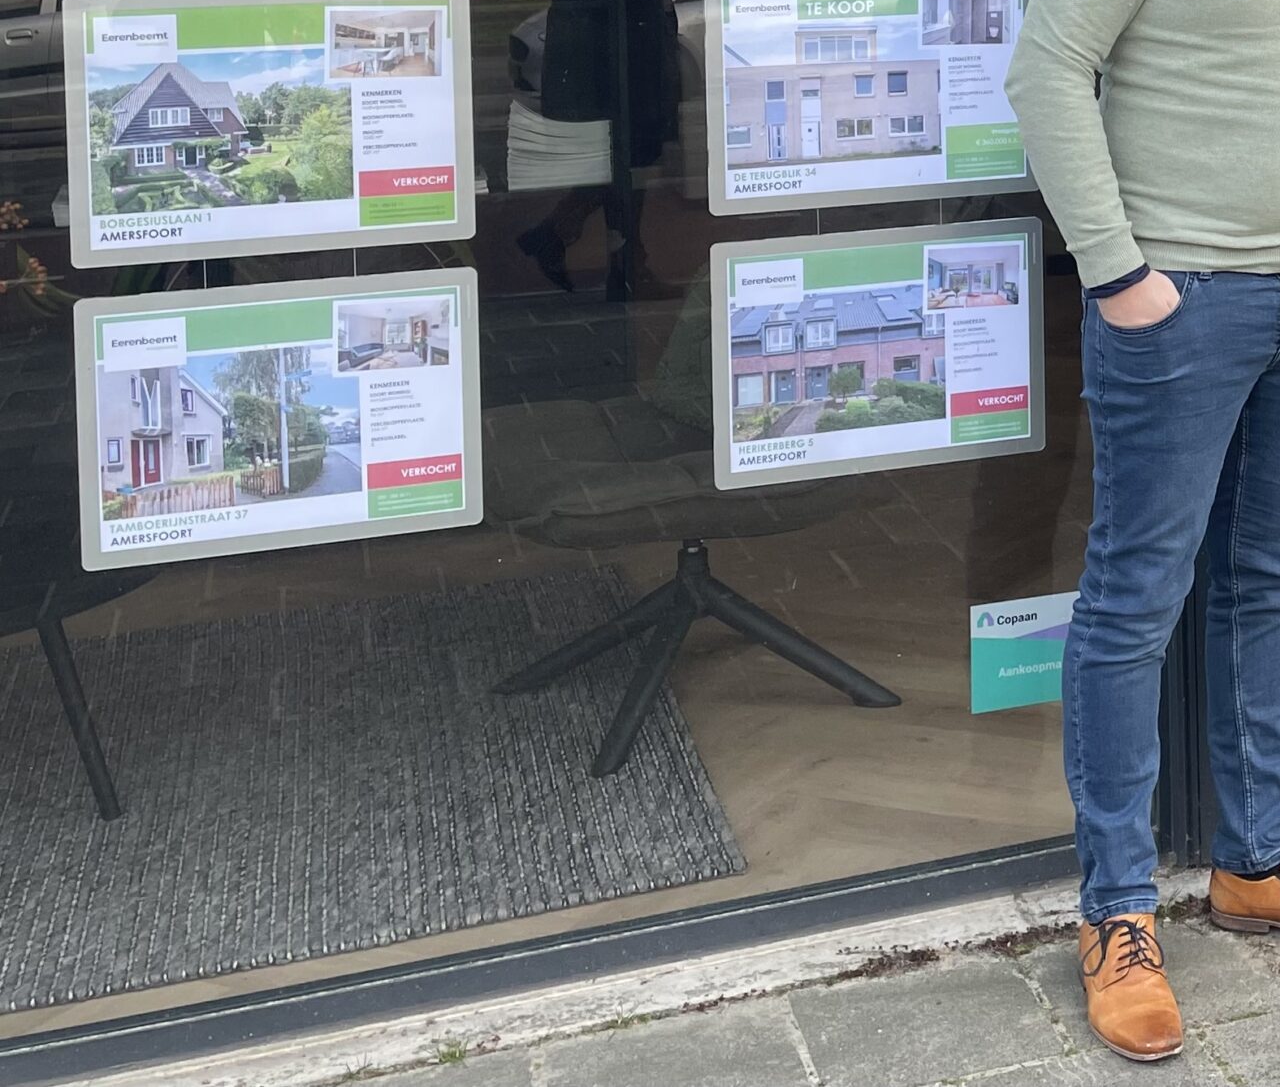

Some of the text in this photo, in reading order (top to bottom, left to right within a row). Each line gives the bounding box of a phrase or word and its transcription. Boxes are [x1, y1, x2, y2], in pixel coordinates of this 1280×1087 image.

[805, 0, 875, 16] TE KOOP
[101, 31, 169, 42] Eerenbeemt
[393, 175, 449, 188] VERKOCHT
[734, 167, 817, 182] DE TERUGBLIK 34
[734, 179, 803, 194] AMERSFOORT
[100, 212, 212, 230] BORGESIUSLAAN 1
[100, 227, 183, 242] AMERSFOORT
[741, 274, 797, 286] Eerenbeemt
[111, 334, 177, 348] Eerenbeemt
[977, 393, 1025, 407] VERKOCHT
[738, 438, 806, 455] HERIKERBERG
[738, 449, 807, 466] AMERSFOORT
[401, 462, 457, 478] VERKOCHT
[109, 509, 249, 535] TAMBOERIJNSTRAAT 37
[110, 528, 193, 547] AMERSFOORT
[996, 612, 1038, 626] Copaan
